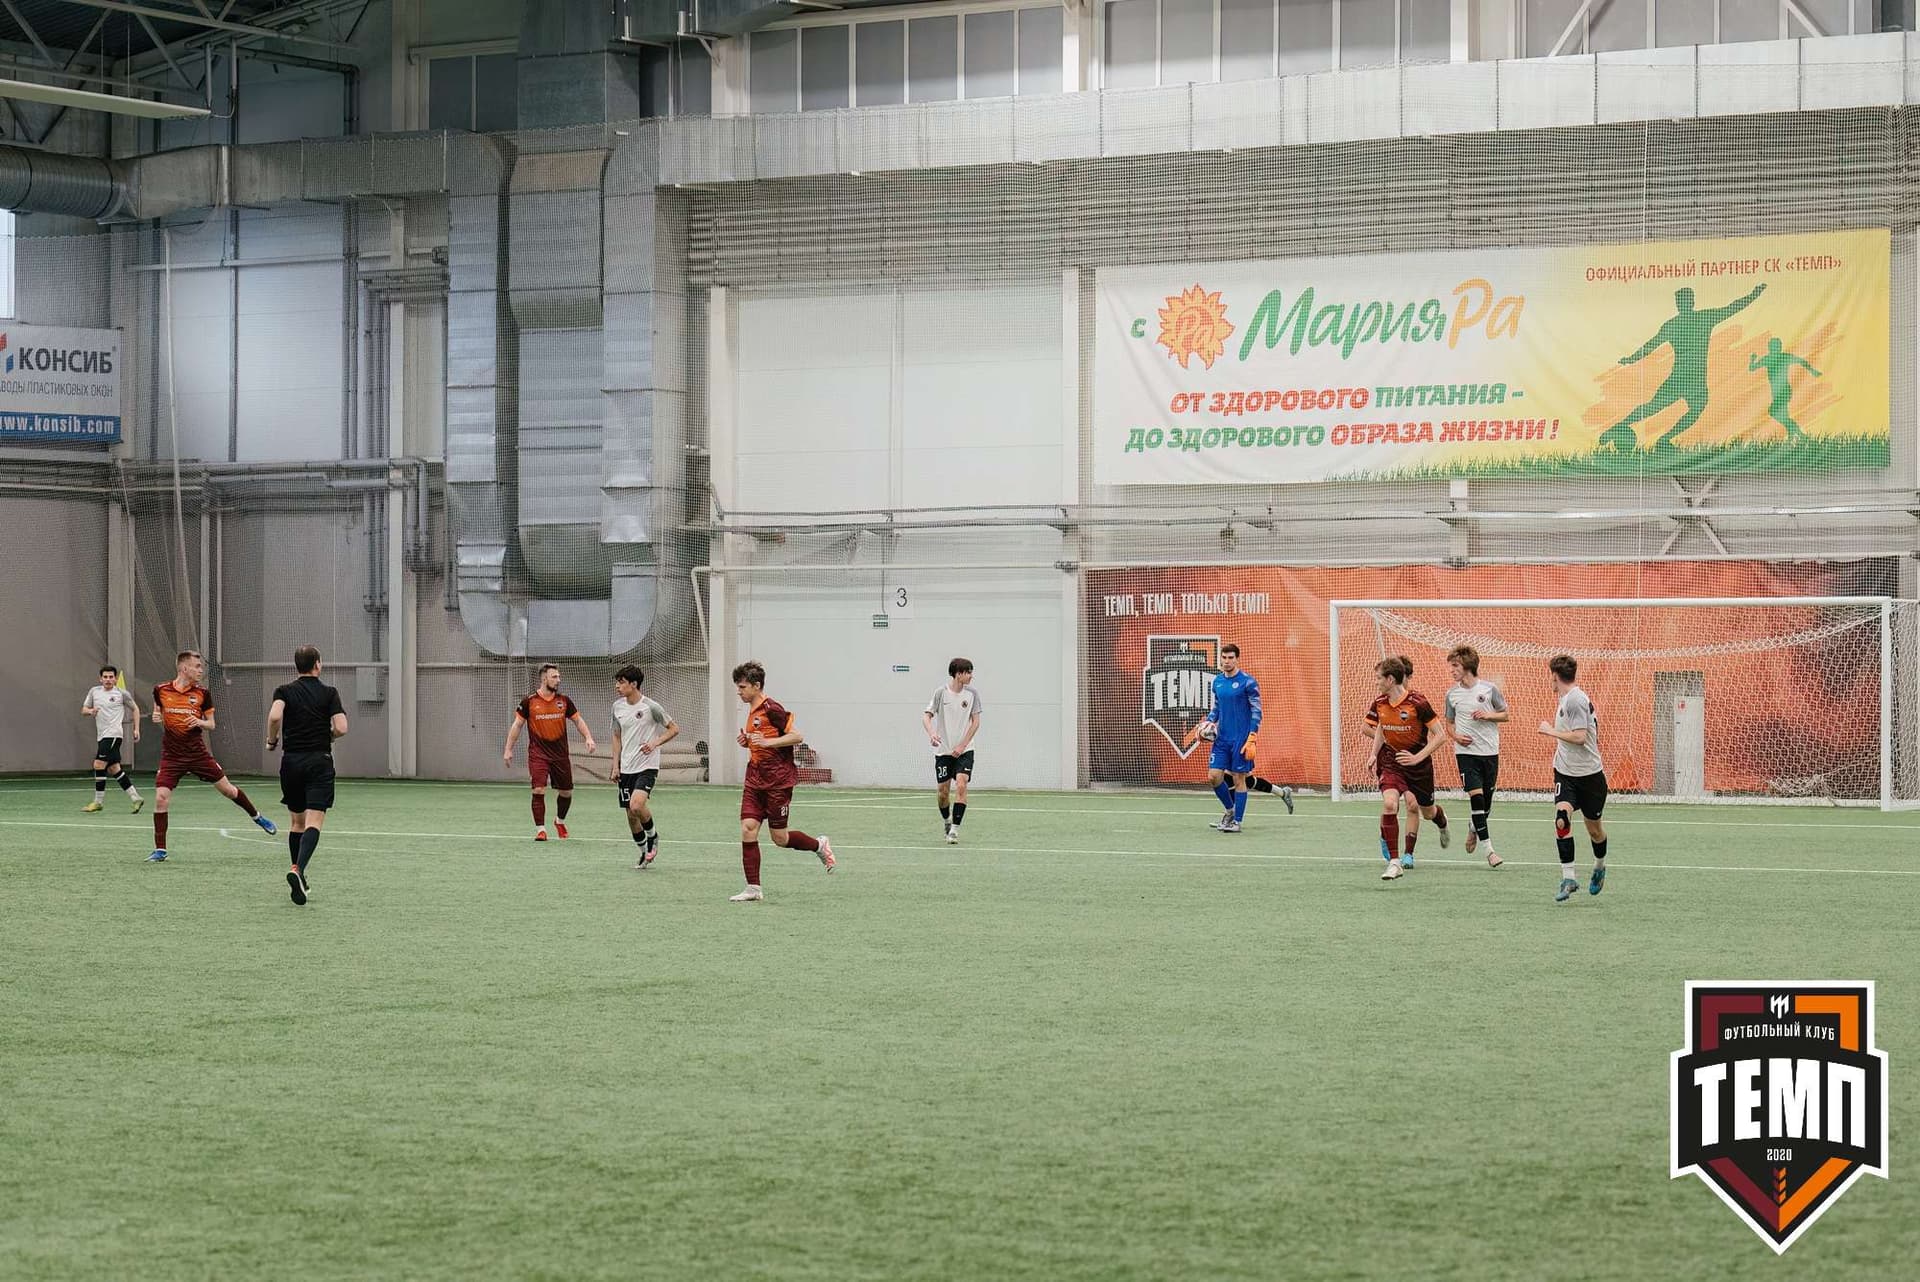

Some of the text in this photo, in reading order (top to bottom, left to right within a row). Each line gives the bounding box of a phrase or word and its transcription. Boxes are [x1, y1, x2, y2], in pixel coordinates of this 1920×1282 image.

[1586, 255, 1842, 283] ОФИЦИАЛЬНЫЙ ПАРТНЕР СК «ТЕМП»
[19, 347, 113, 374] КОНСИБ
[0, 381, 113, 398] ВОДЫ ПЛАСТИКОВЫХ ОКОН
[1170, 392, 1205, 413] ОТ
[1208, 388, 1369, 416] ЗДОРОВОГО
[1375, 383, 1507, 408] ПИТАНИЯ
[1124, 428, 1164, 453] ДО
[1167, 425, 1325, 453] ЗДОРОВОГО
[1331, 421, 1434, 446] ОБРАЗА
[896, 587, 908, 608] 3
[1104, 592, 1270, 617] ТЕМП, ТЕМП, ТОЛЬКО ТЕМП!
[620, 788, 630, 802] 15
